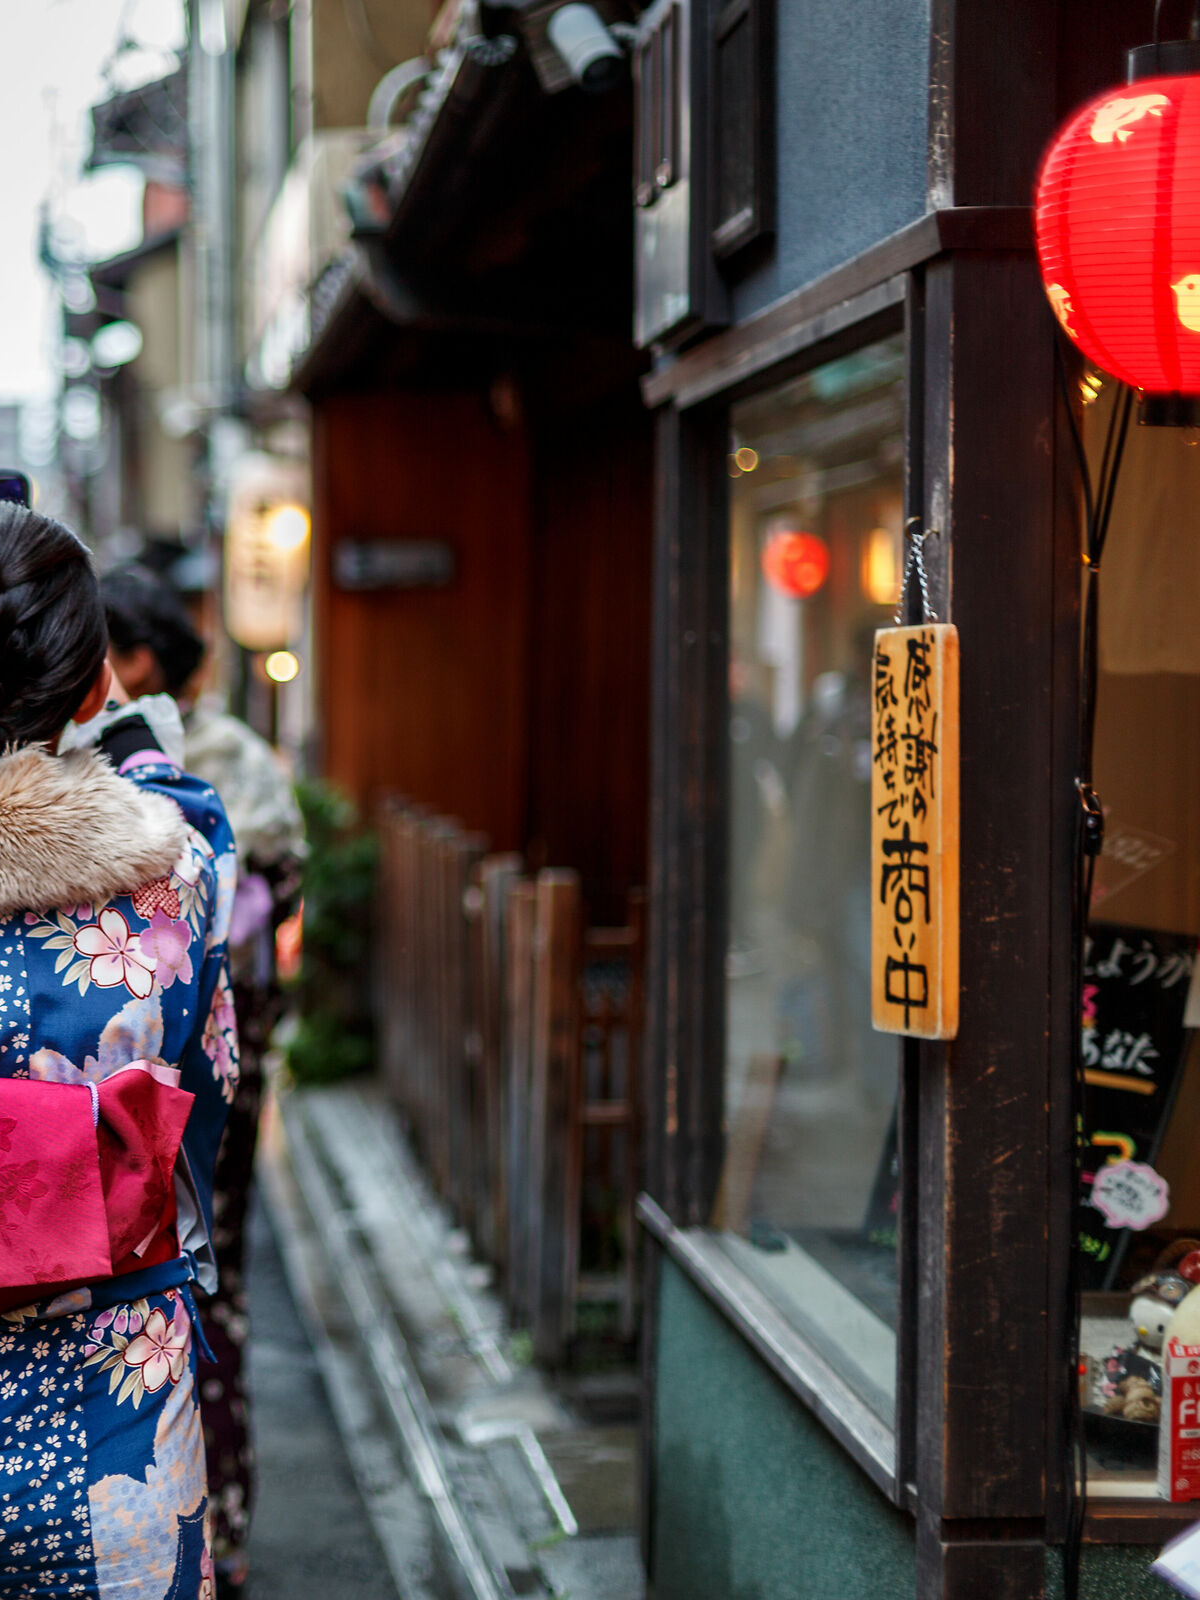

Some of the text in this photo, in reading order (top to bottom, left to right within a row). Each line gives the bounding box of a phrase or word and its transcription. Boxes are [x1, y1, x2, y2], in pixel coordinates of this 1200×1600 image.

[873, 643, 909, 829] 気持ちで
[900, 631, 939, 824] 感謝の
[879, 821, 931, 1030] 商い中
